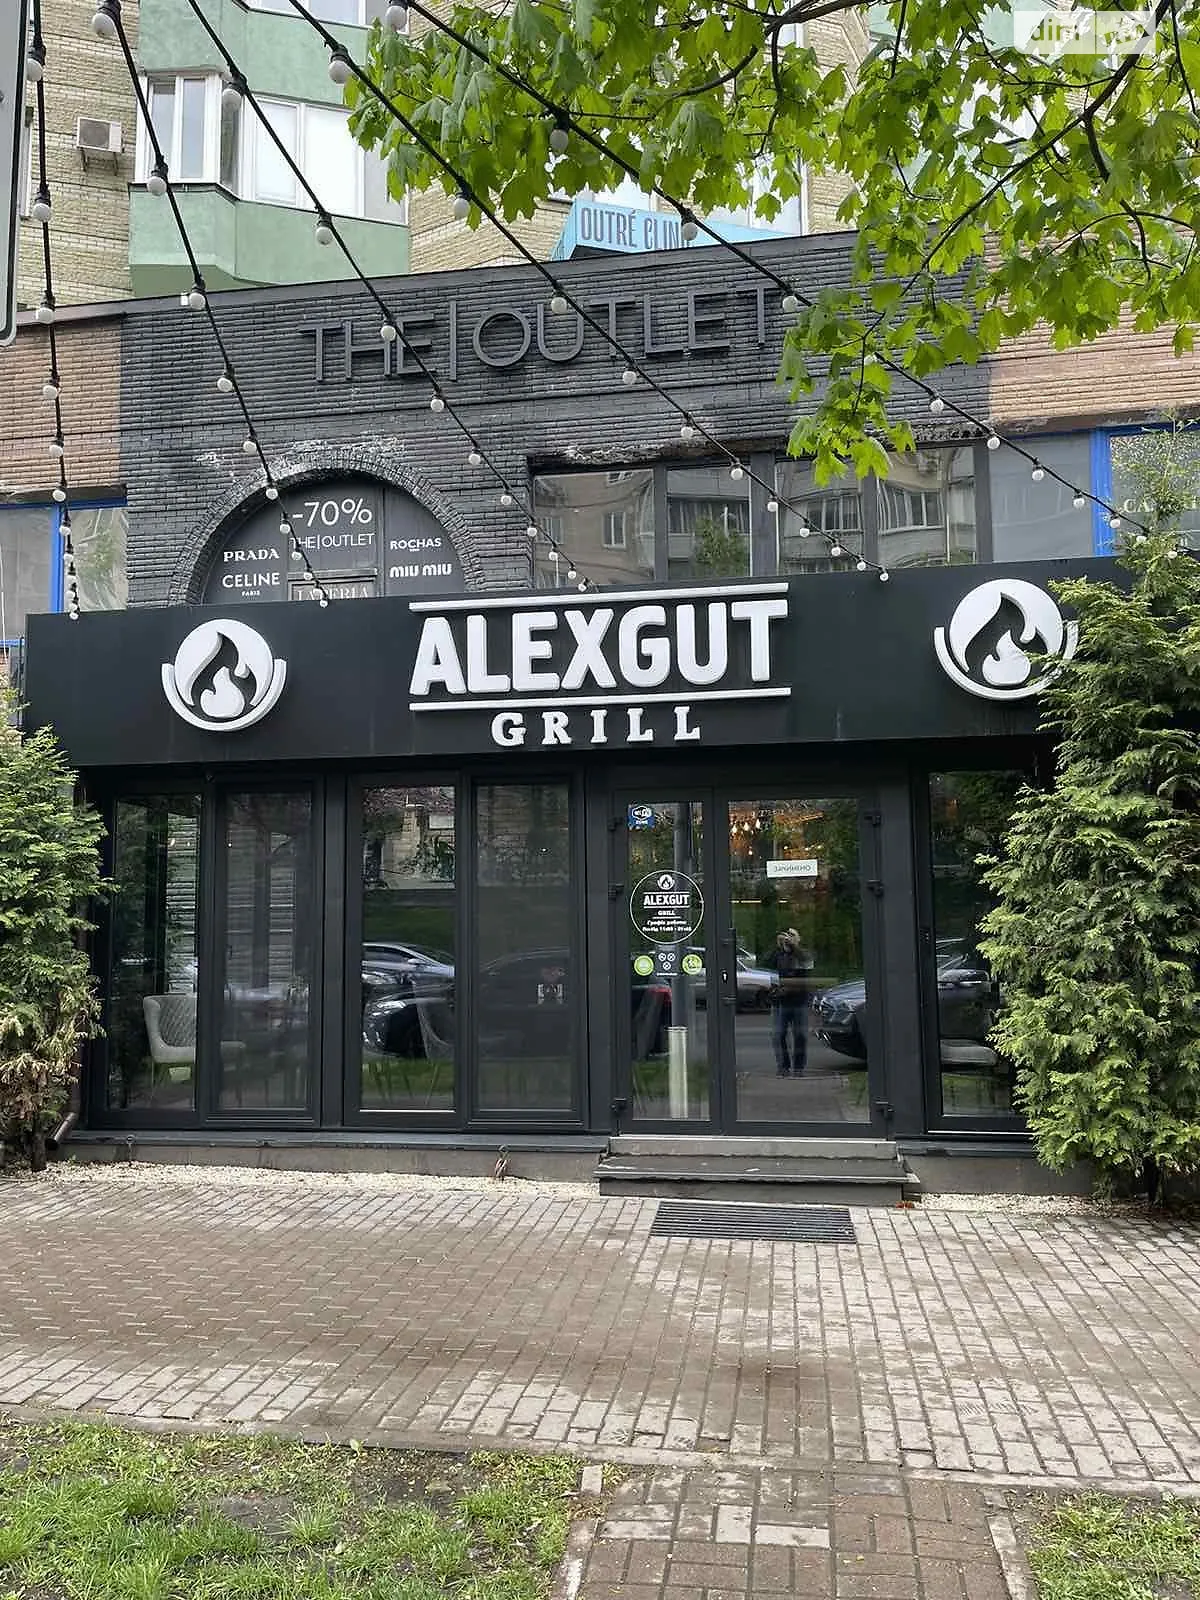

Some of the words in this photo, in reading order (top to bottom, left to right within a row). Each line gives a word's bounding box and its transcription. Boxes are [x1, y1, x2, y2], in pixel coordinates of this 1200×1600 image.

[580, 207, 638, 248] OUTRÉ
[292, 498, 373, 527] -70%
[223, 548, 280, 562] PRADA
[390, 537, 442, 551] ROCHAS
[222, 572, 280, 589] CELINE
[409, 599, 789, 696] ALEXGUT
[491, 706, 701, 747] GRILL
[643, 894, 690, 906] ALEXGUT
